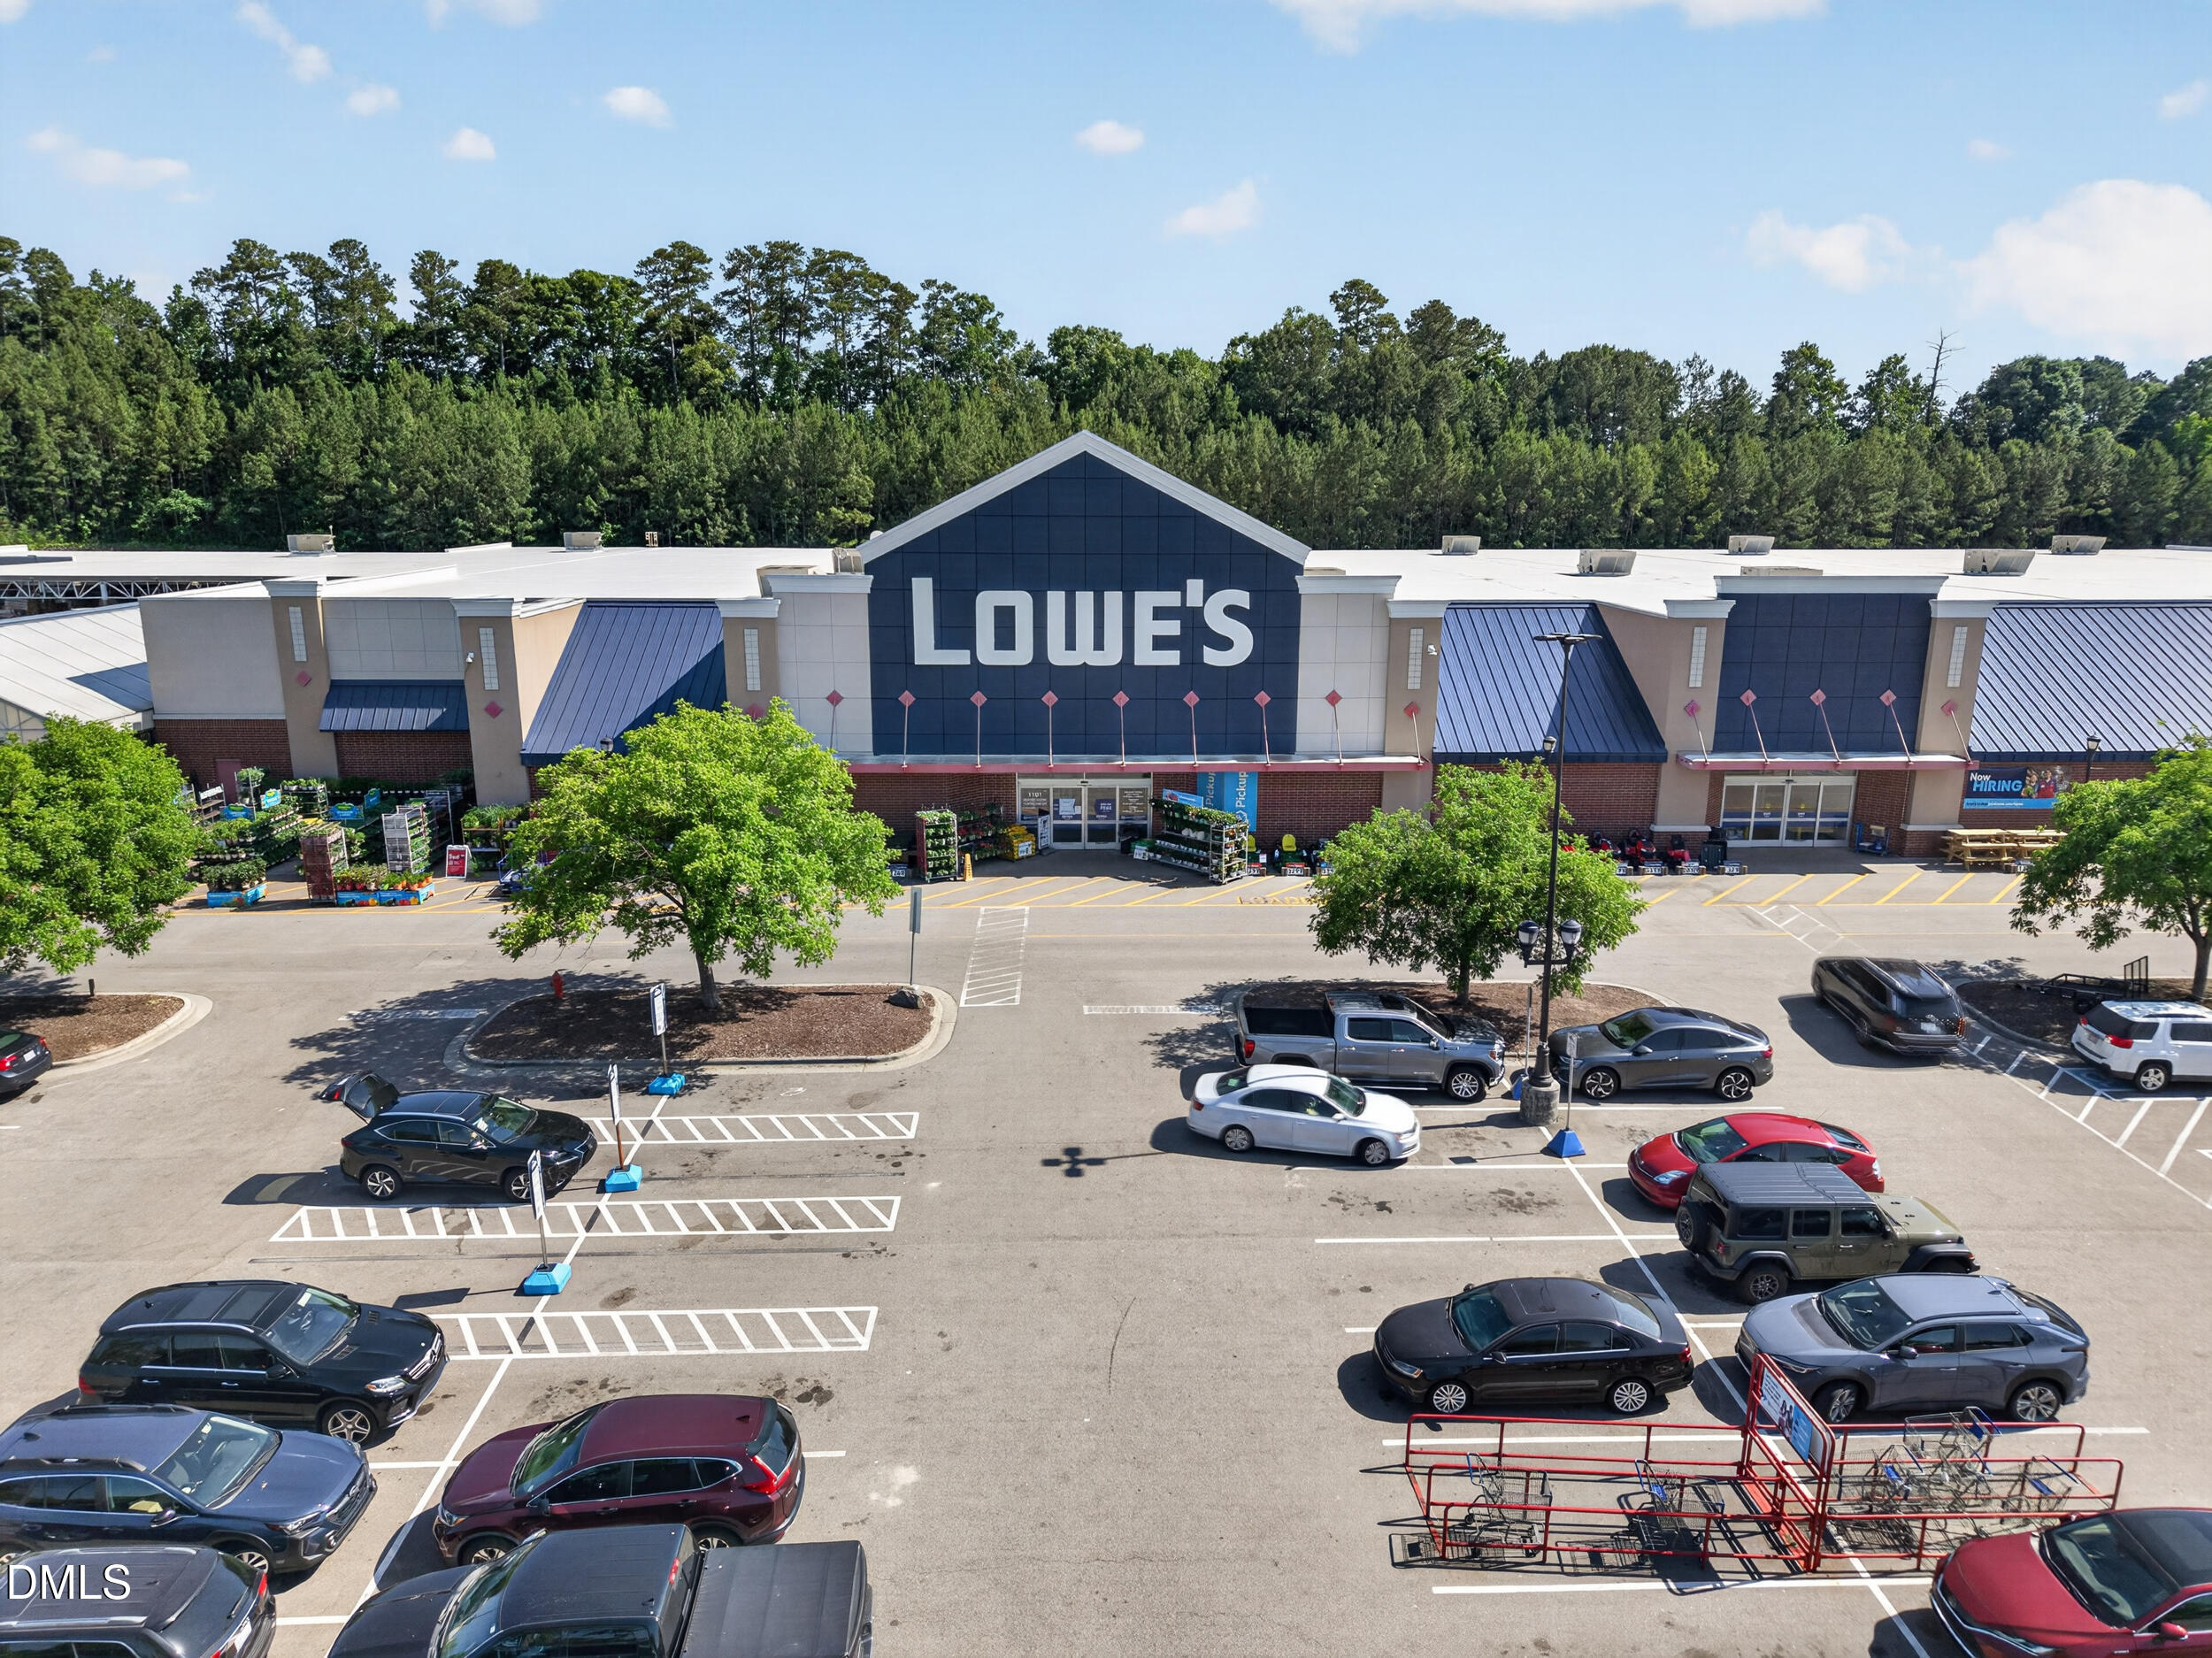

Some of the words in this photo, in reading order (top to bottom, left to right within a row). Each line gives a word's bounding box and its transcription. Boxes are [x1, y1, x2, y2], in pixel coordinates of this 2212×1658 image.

[911, 577, 1254, 667] LOWE'S
[1970, 772, 1991, 781] Now
[1972, 779, 2023, 792] HIRING
[1235, 771, 1248, 808] Pickup
